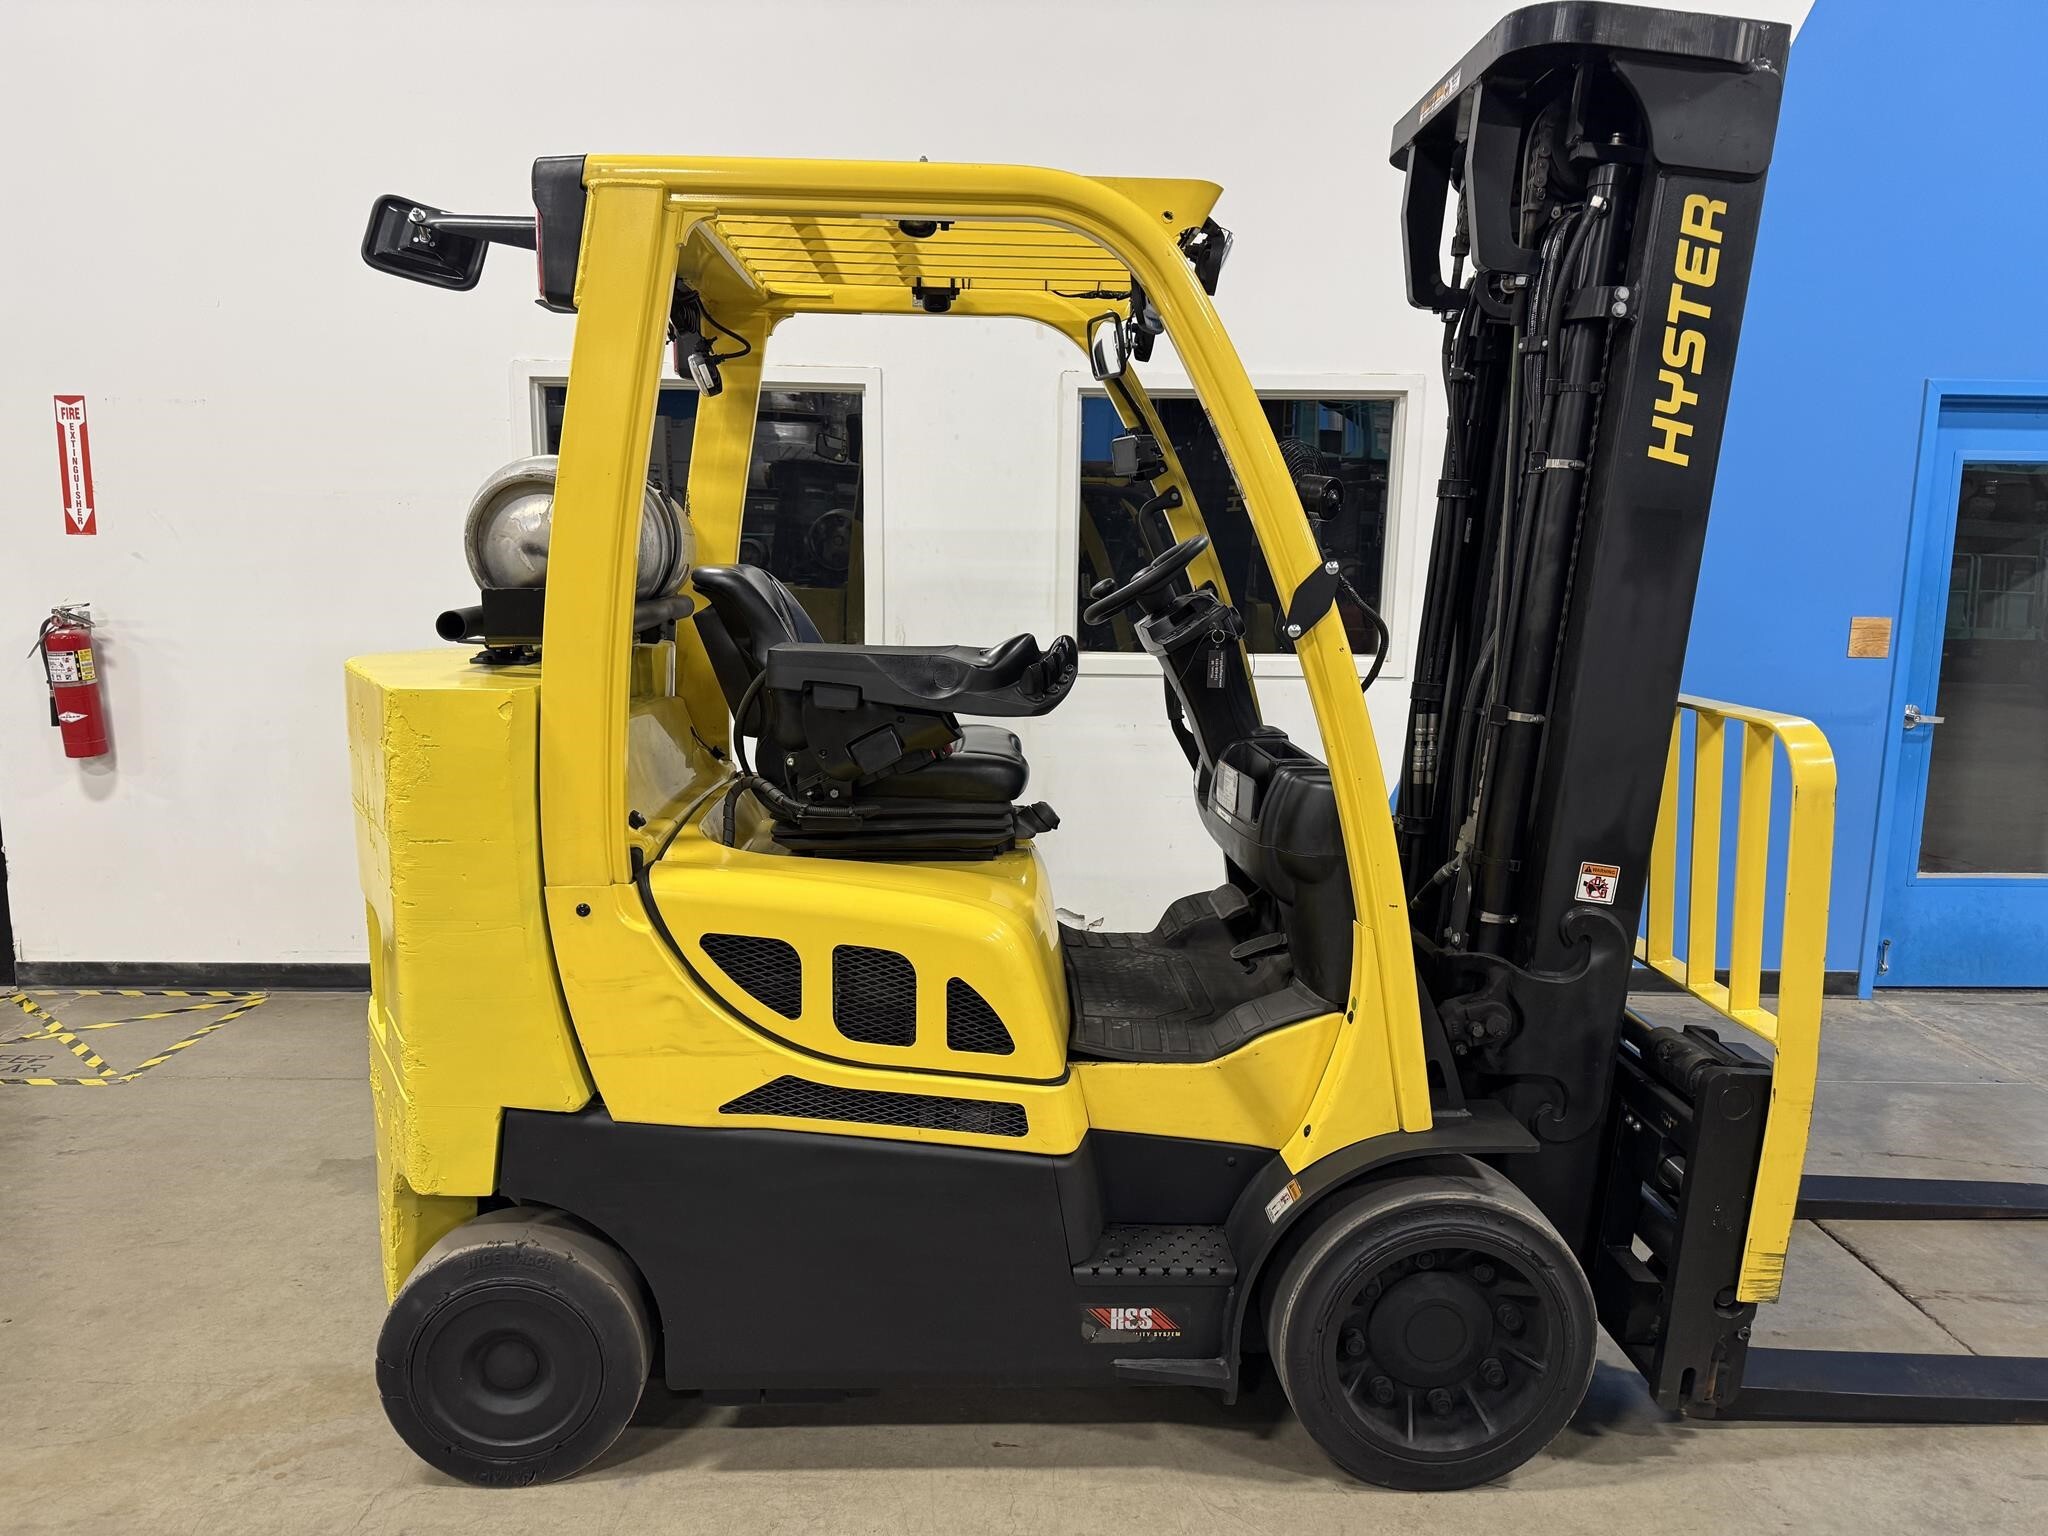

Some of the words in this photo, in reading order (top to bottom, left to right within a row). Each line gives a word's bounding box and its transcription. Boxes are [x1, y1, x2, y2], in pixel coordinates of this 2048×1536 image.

[1647, 193, 1728, 467] HYSTER
[60, 407, 81, 420] FIRE
[69, 422, 84, 525] EXTINGUISHER
[1592, 867, 1616, 875] WARNING
